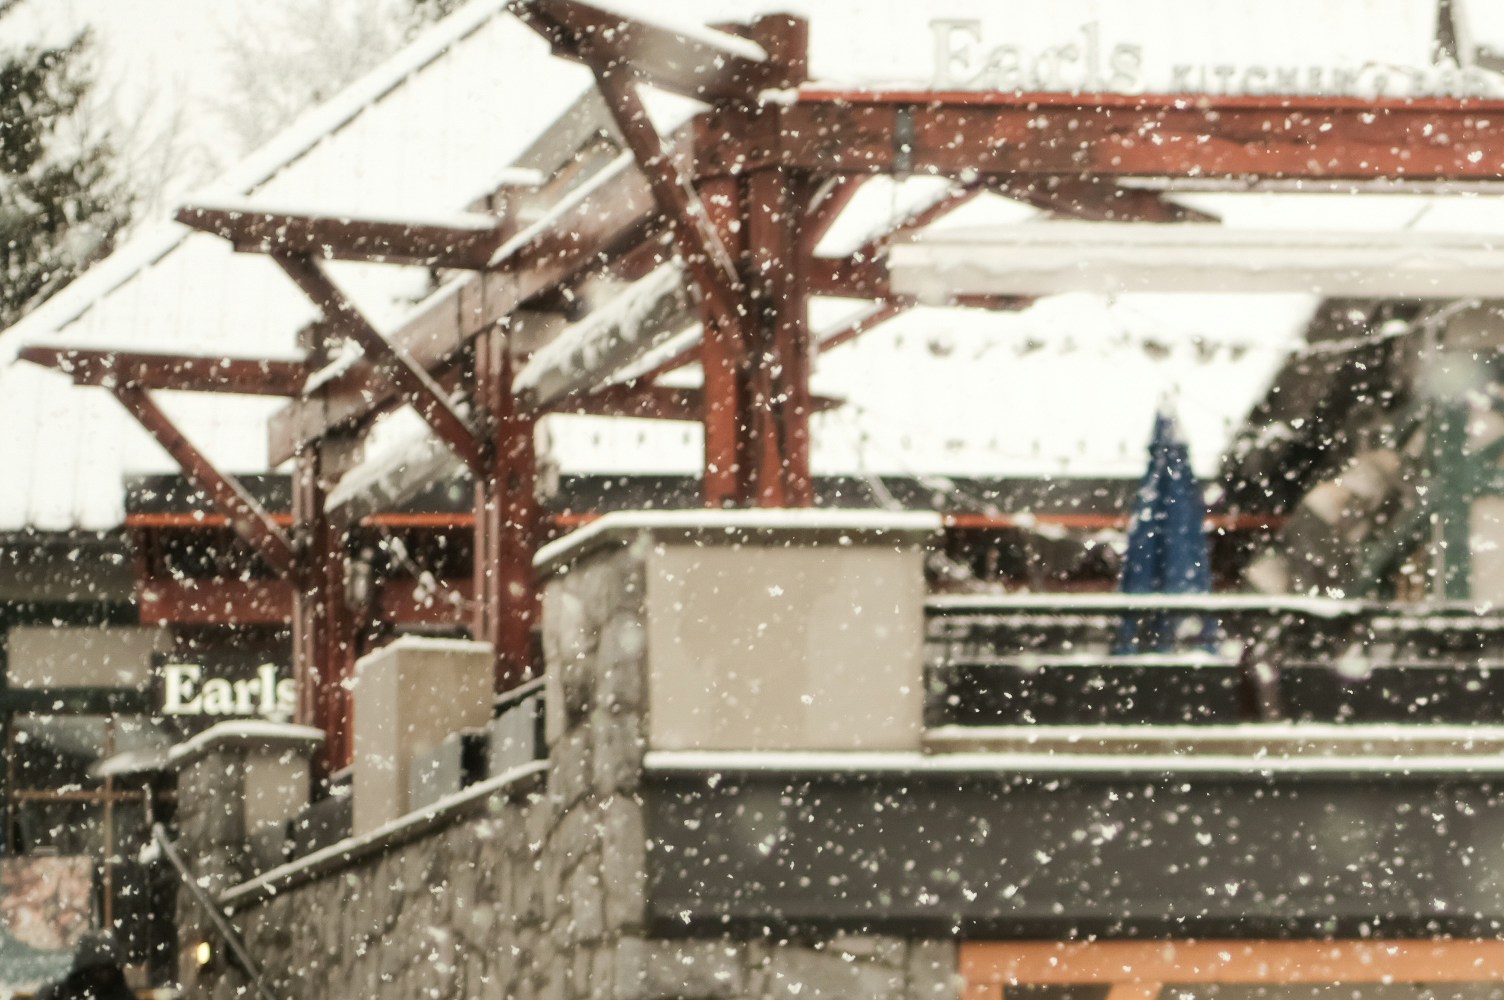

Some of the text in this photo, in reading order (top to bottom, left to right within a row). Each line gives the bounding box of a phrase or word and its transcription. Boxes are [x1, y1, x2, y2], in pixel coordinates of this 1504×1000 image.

[928, 18, 1143, 95] Earls
[1168, 63, 1358, 97] KITCHEN
[162, 662, 298, 715] Earls
